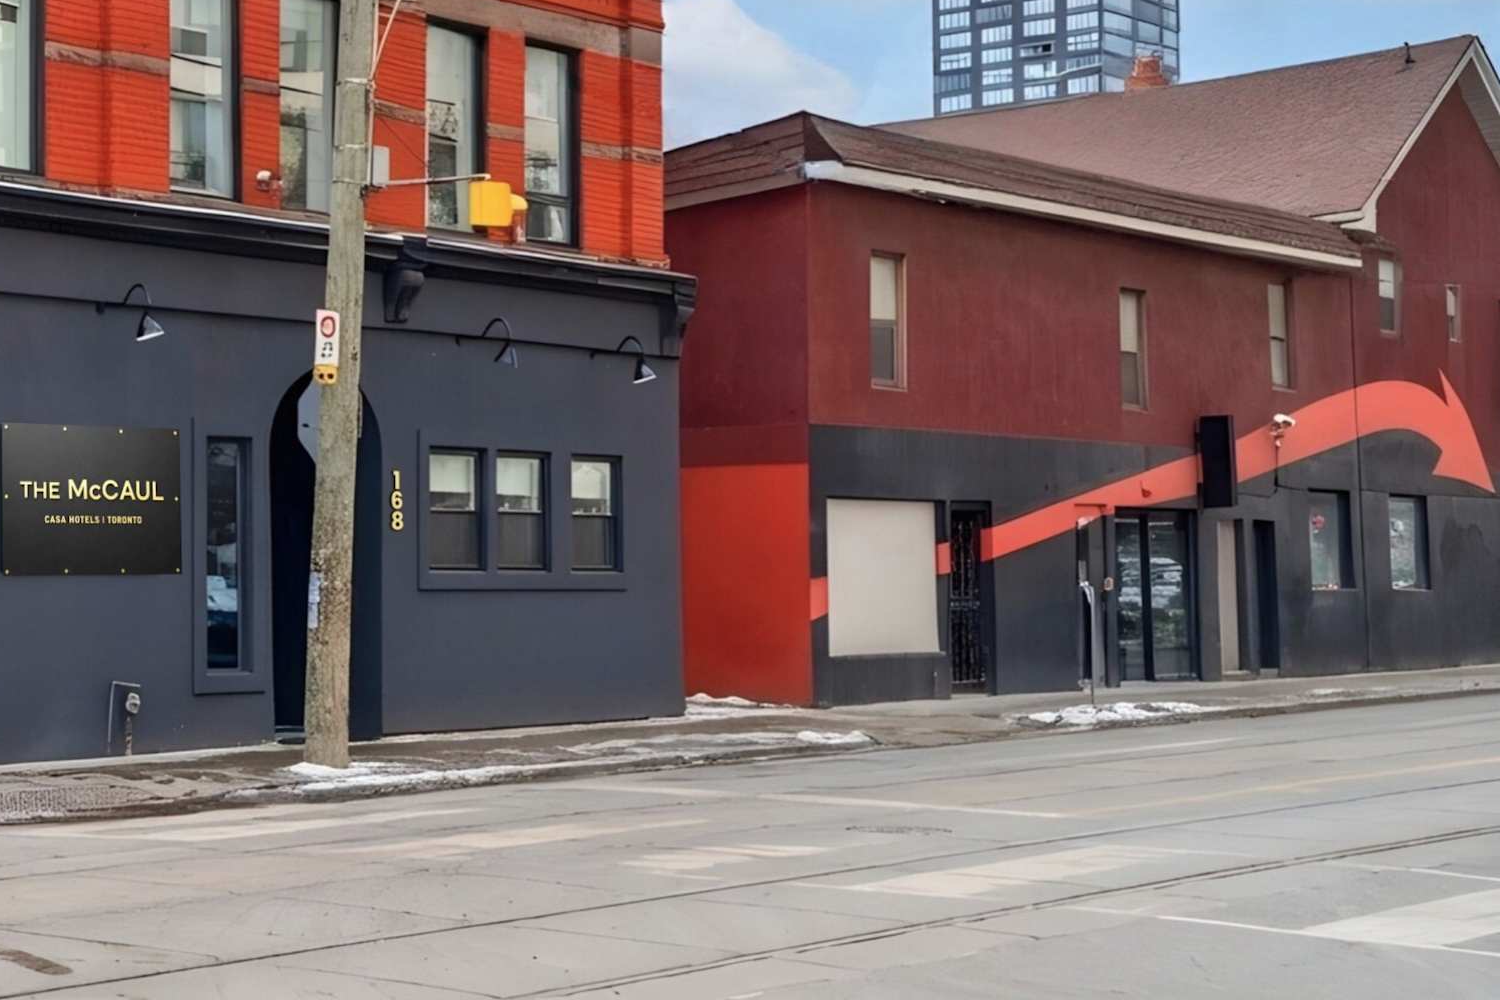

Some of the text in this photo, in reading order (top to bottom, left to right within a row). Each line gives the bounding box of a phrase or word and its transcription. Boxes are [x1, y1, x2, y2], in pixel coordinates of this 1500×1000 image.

[19, 478, 165, 502] THE McCAUL
[390, 470, 404, 531] 168
[44, 515, 66, 525] CASA
[68, 515, 100, 525] HOTELS
[107, 515, 143, 525] TORONTO
